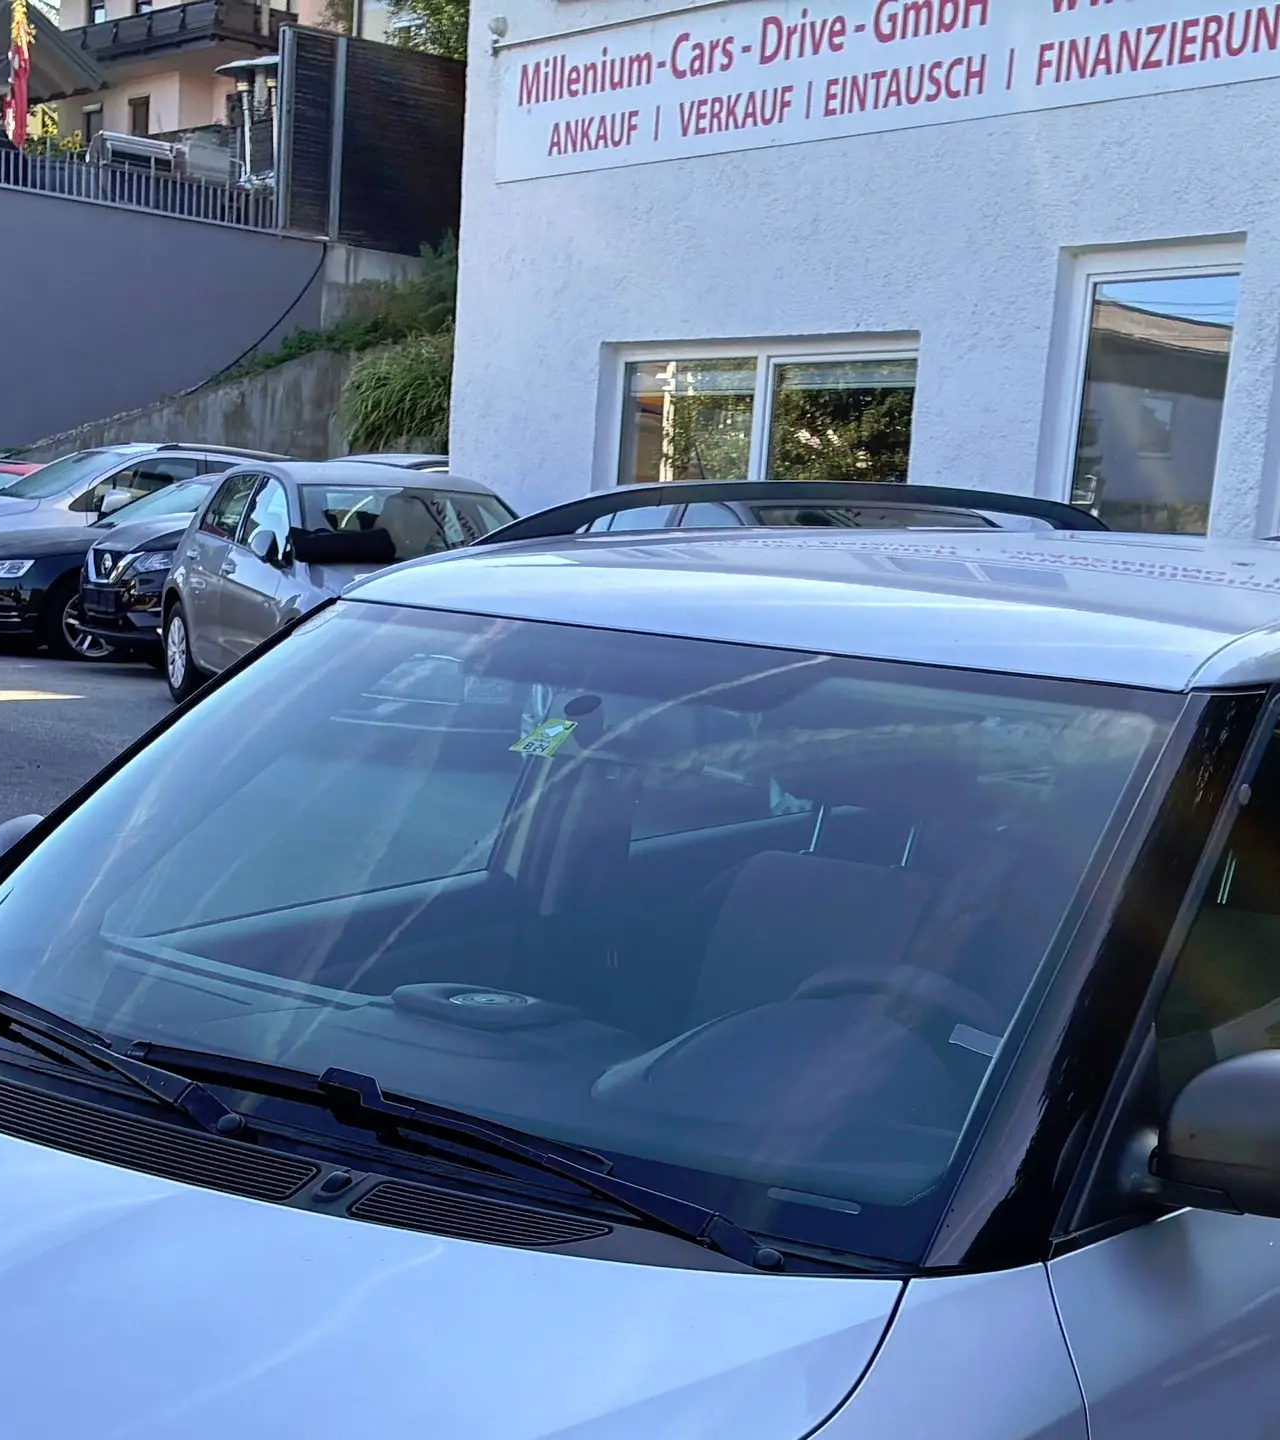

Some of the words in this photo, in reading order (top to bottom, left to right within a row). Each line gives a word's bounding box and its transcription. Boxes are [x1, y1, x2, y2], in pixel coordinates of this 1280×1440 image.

[548, 109, 639, 157] ANKAUF
[679, 85, 794, 137] VERKAUF
[823, 53, 987, 118] EINTAUSCH
